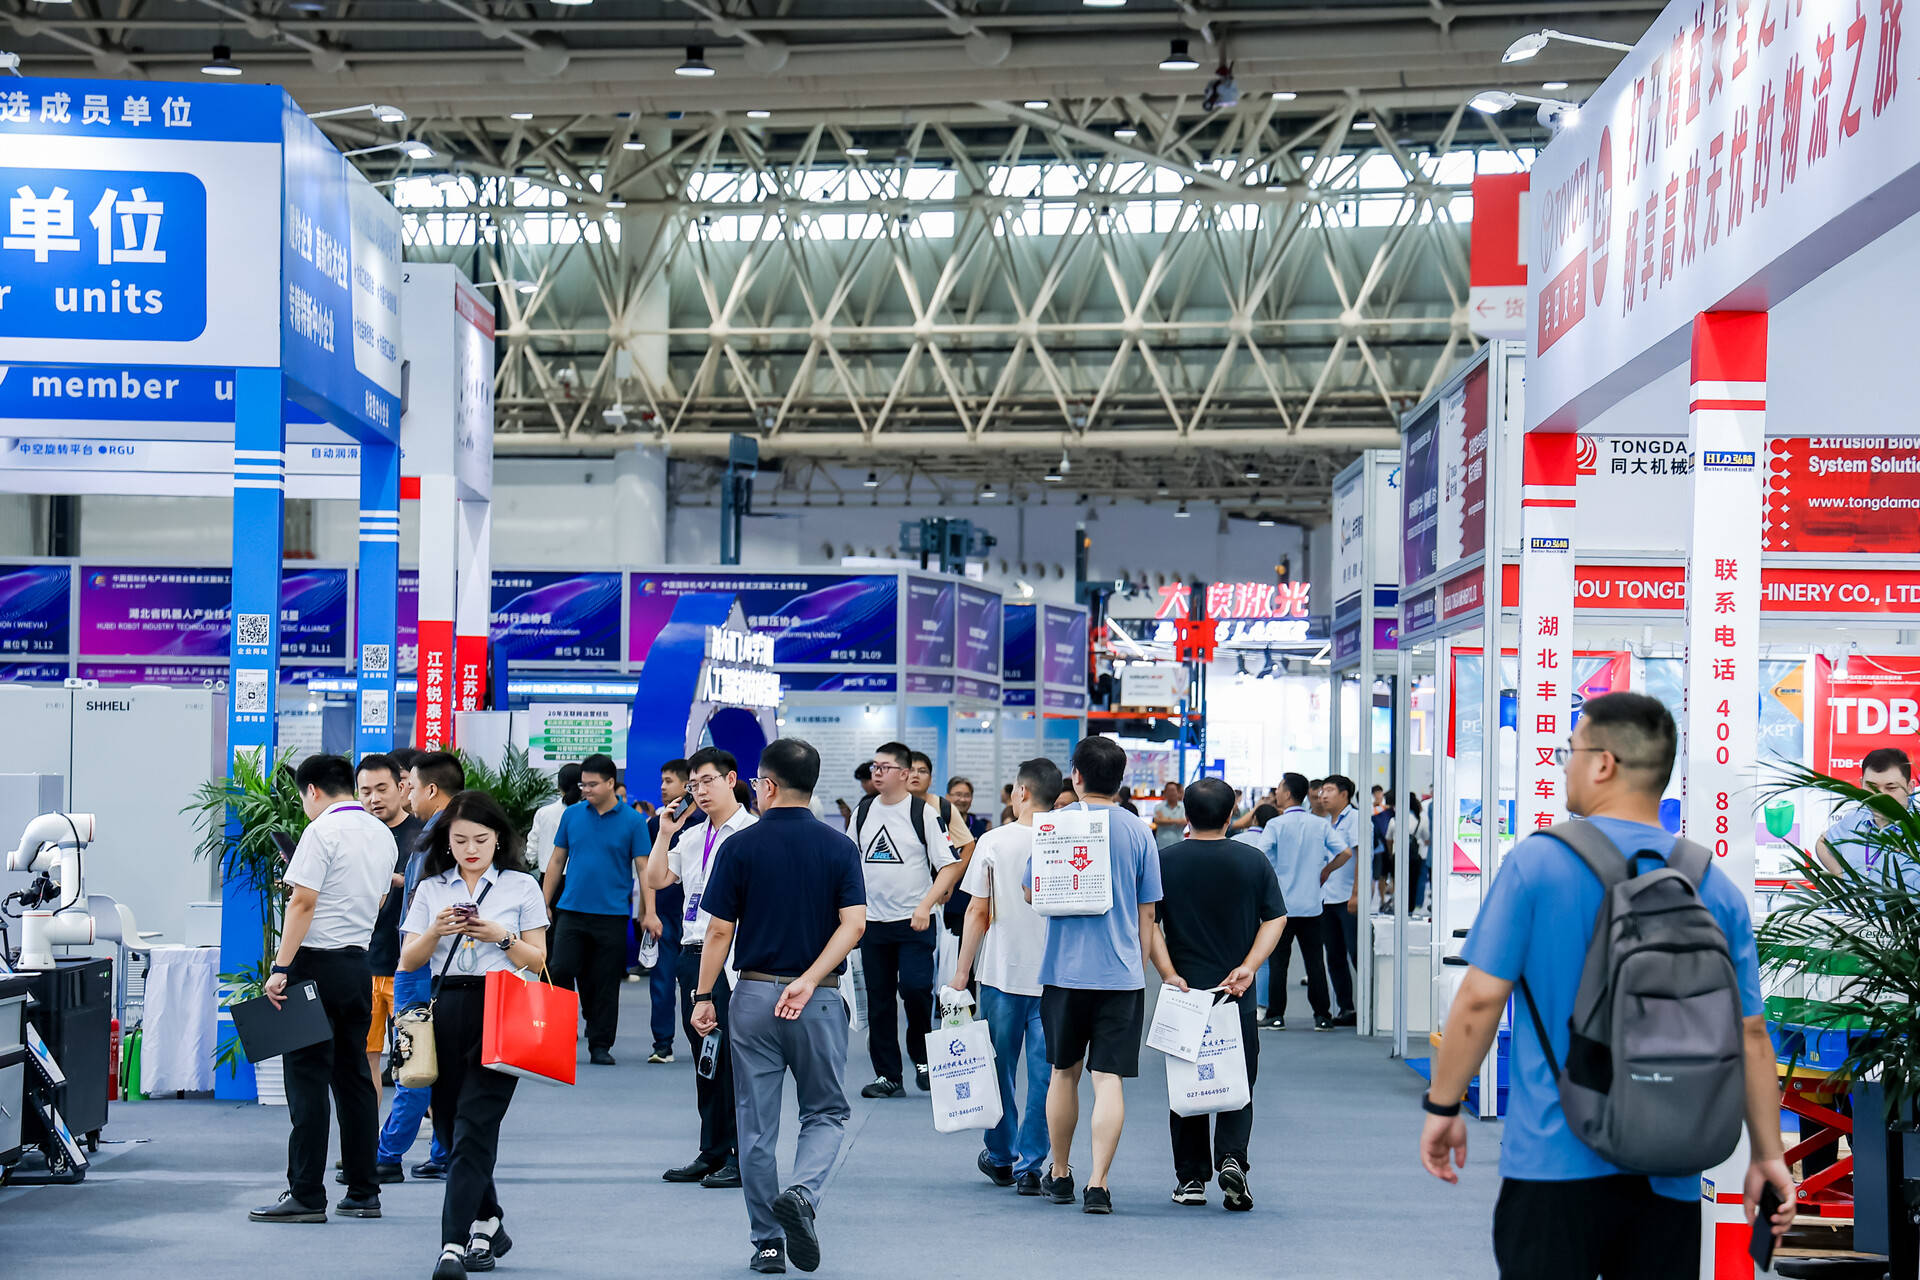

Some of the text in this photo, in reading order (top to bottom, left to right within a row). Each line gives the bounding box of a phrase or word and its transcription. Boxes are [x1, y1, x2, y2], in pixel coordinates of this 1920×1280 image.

[0, 91, 192, 127] 选成员单位
[1555, 158, 1589, 251] TOYOTA
[3, 185, 166, 266] 单位
[56, 279, 162, 314] units
[1544, 267, 1580, 338] 丰田叉车
[32, 372, 179, 399] member
[20, 443, 93, 456] 中空旋转平台
[1610, 440, 1687, 454] TONGDA
[1611, 458, 1688, 475] 同大机械
[1809, 455, 1867, 476] System
[1839, 584, 1880, 605] CO.,
[118, 622, 140, 630] ROBOT
[143, 622, 174, 630] INDUSTRY
[86, 701, 130, 711] SHHELI
[1827, 698, 1920, 735] TDB
